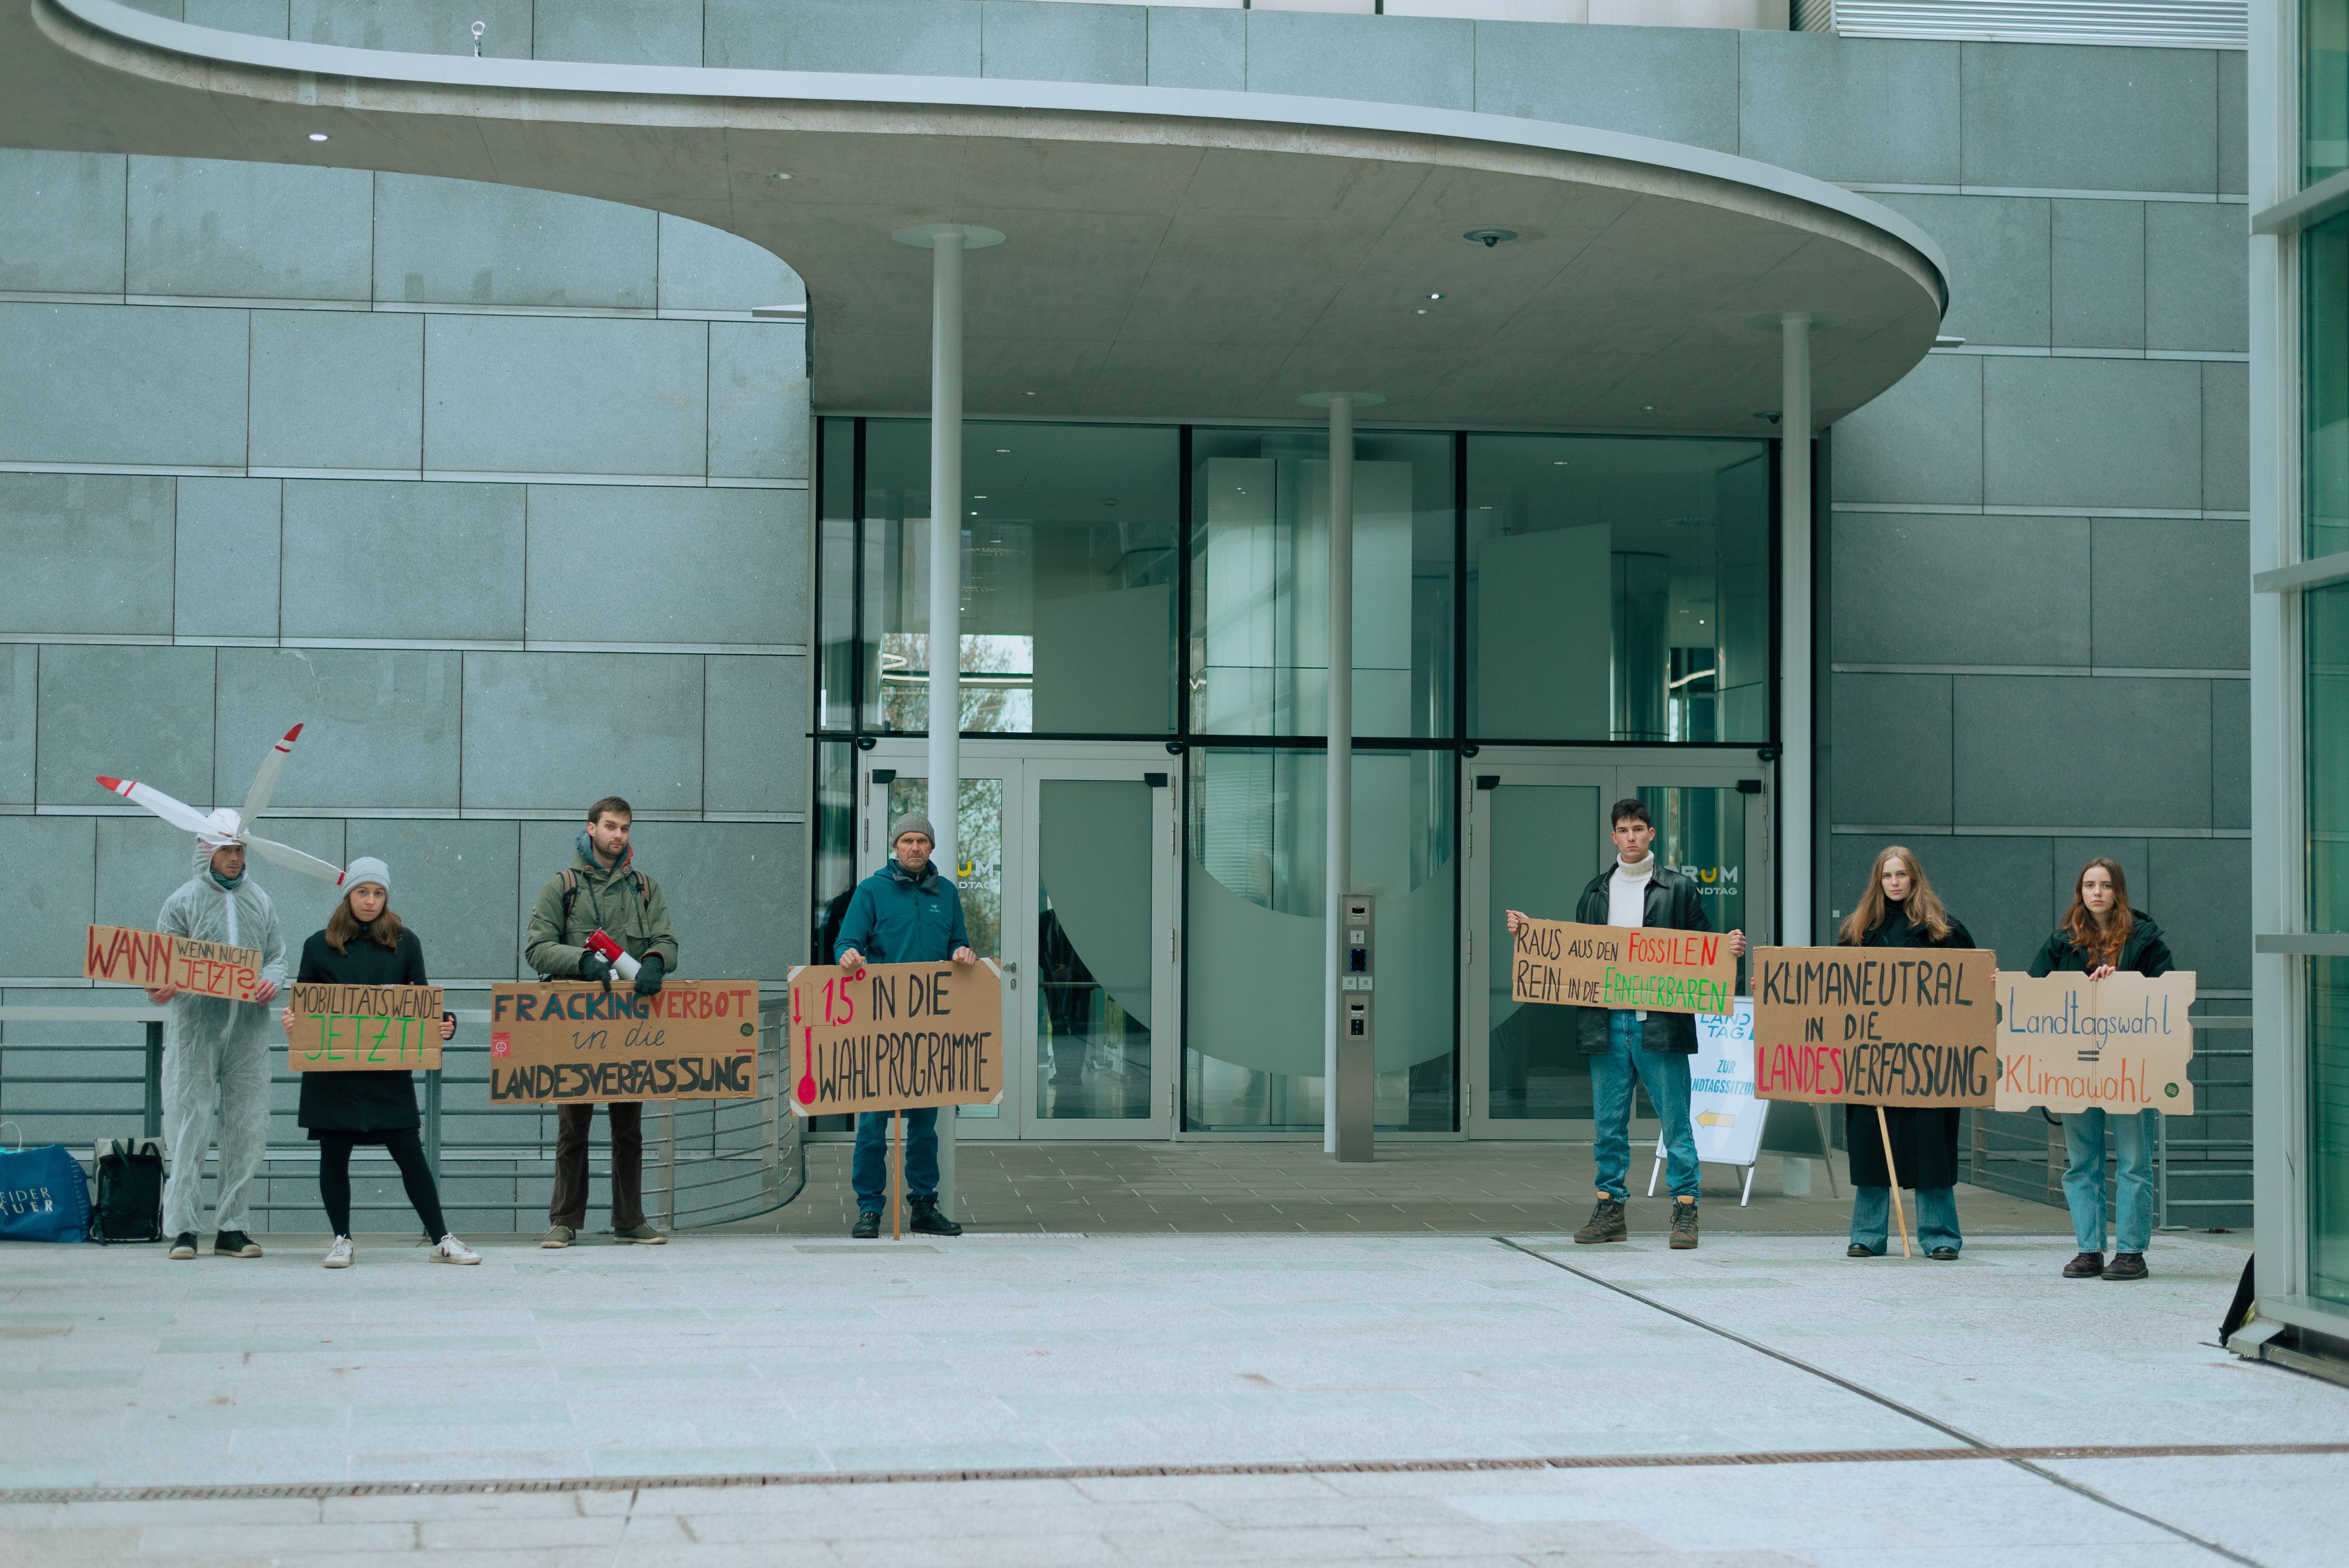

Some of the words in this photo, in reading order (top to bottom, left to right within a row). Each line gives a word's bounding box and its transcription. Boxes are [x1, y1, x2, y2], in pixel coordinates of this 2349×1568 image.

[958, 860, 994, 877] UM
[1664, 865, 1738, 883] RUM
[1697, 887, 1738, 896] NDTAG
[89, 926, 173, 984] WANN
[220, 944, 261, 968] NICHT
[1517, 923, 1561, 960] RAUS
[1569, 939, 1593, 958] AUS
[1597, 942, 1618, 961] DEN
[1628, 932, 1718, 966] FOSSILEN
[175, 958, 256, 1000] JETZT?
[873, 975, 895, 1021] IN
[909, 971, 952, 1018] DIE
[1517, 960, 1561, 1002] REIN
[1568, 978, 1580, 1001] IN
[1583, 981, 1600, 1004] DIE
[1604, 967, 1727, 1013] ERNEUERBAREN
[1763, 960, 1973, 1006] KLIMANEUTRAL
[294, 986, 443, 1019] MOBILITÄTSWENDE
[2010, 986, 2171, 1049] Landtagswahl
[304, 1015, 425, 1063] JETZT!
[573, 1021, 608, 1049] in
[625, 1021, 665, 1048] die
[1708, 1025, 1744, 1039] TAG
[1805, 1016, 1823, 1042] IN
[1843, 1011, 1882, 1041] DIE
[491, 1055, 752, 1101] LANDESVERFASSUNG
[819, 1032, 992, 1102] WAHLPROGRAMME
[1691, 1078, 1755, 1096] NDTAGSSITZU
[1717, 1059, 1736, 1074] ZUR
[1758, 1042, 1988, 1097] LANDESVERFASSUNG
[2005, 1055, 2152, 1103] Klimawahl
[0, 1187, 51, 1203] EIDER
